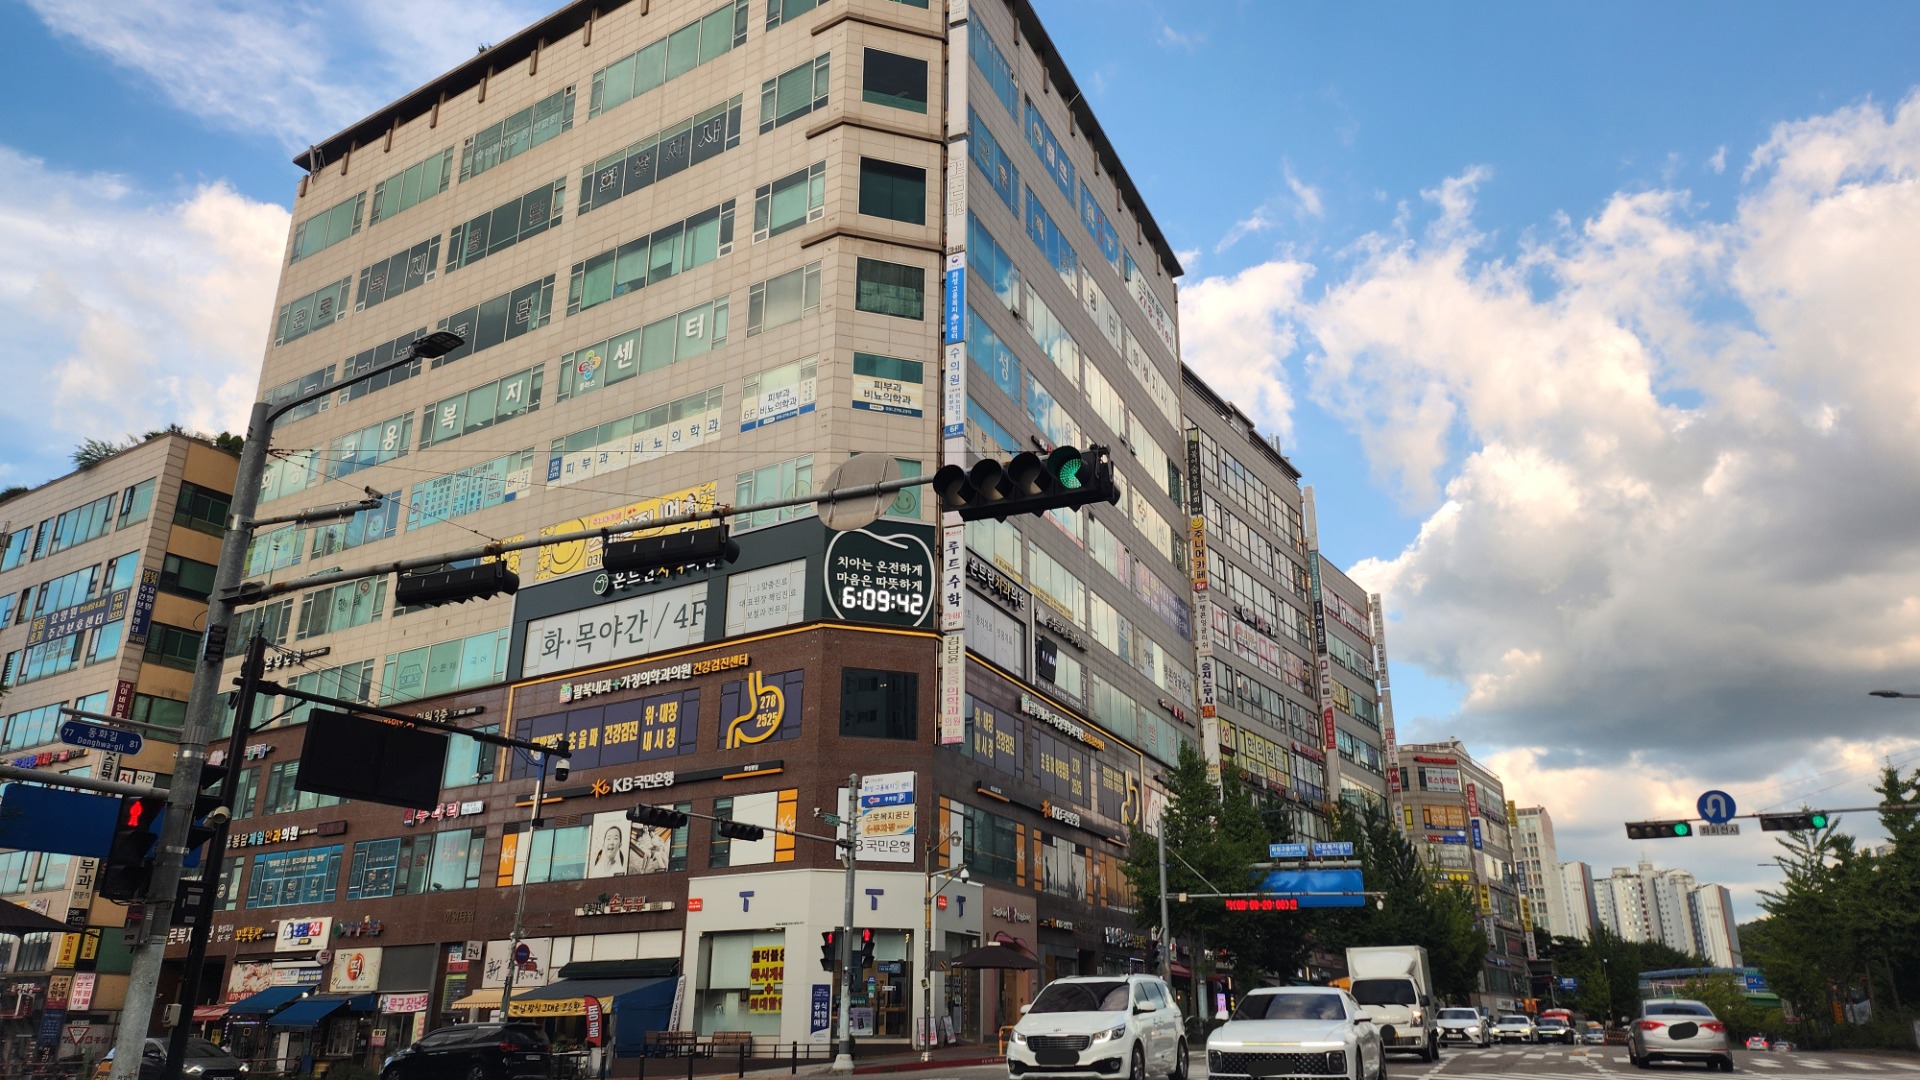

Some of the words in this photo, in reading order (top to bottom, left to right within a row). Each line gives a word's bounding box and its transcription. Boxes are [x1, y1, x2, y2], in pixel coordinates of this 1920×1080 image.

[768, 388, 790, 402] 피부과
[874, 380, 902, 392] 피부과
[760, 397, 797, 415] 비뇨의학과
[864, 390, 911, 405] 비뇨의학과
[744, 408, 755, 420] 6F
[949, 424, 960, 433] 6F
[1194, 530, 1207, 580] 주니어카페
[837, 556, 873, 571] 치아는
[876, 561, 923, 577] 온전하게
[946, 540, 962, 607] 루트수학
[837, 572, 873, 588] 마음은
[876, 576, 923, 592] 따뜻하게
[145, 587, 155, 610] 요양원
[842, 586, 924, 615] 6:09:42
[51, 607, 78, 624] 요양원
[674, 600, 707, 629] 4F
[48, 613, 103, 639] 주간보호센터
[692, 653, 749, 674] 건강검진센터
[1202, 662, 1214, 705] 승지노무사
[759, 694, 777, 710] 278
[756, 711, 778, 728] 2525
[64, 728, 74, 737] 77
[88, 727, 119, 742] 동화길
[129, 740, 139, 749] 81
[77, 736, 125, 752] Donghwa-gil
[569, 727, 599, 750] 초음파
[604, 720, 639, 746] 건강검진
[643, 726, 676, 752] 내시경
[974, 730, 994, 759] 내시경
[996, 729, 1015, 756] 건강검진
[612, 769, 675, 794] KB국민은행
[866, 810, 910, 823] 근로복지공단
[1700, 825, 1739, 836] 좌회전시
[866, 840, 911, 854] 국민은행
[610, 894, 645, 913] 손두부
[739, 890, 755, 912] T
[865, 888, 884, 910] T
[956, 895, 966, 917] T
[310, 921, 322, 935] 24
[527, 1003, 541, 1012] 방식
[813, 1001, 828, 1011] 공식
[813, 1010, 828, 1020] 체험
[813, 1018, 828, 1028] 매장
